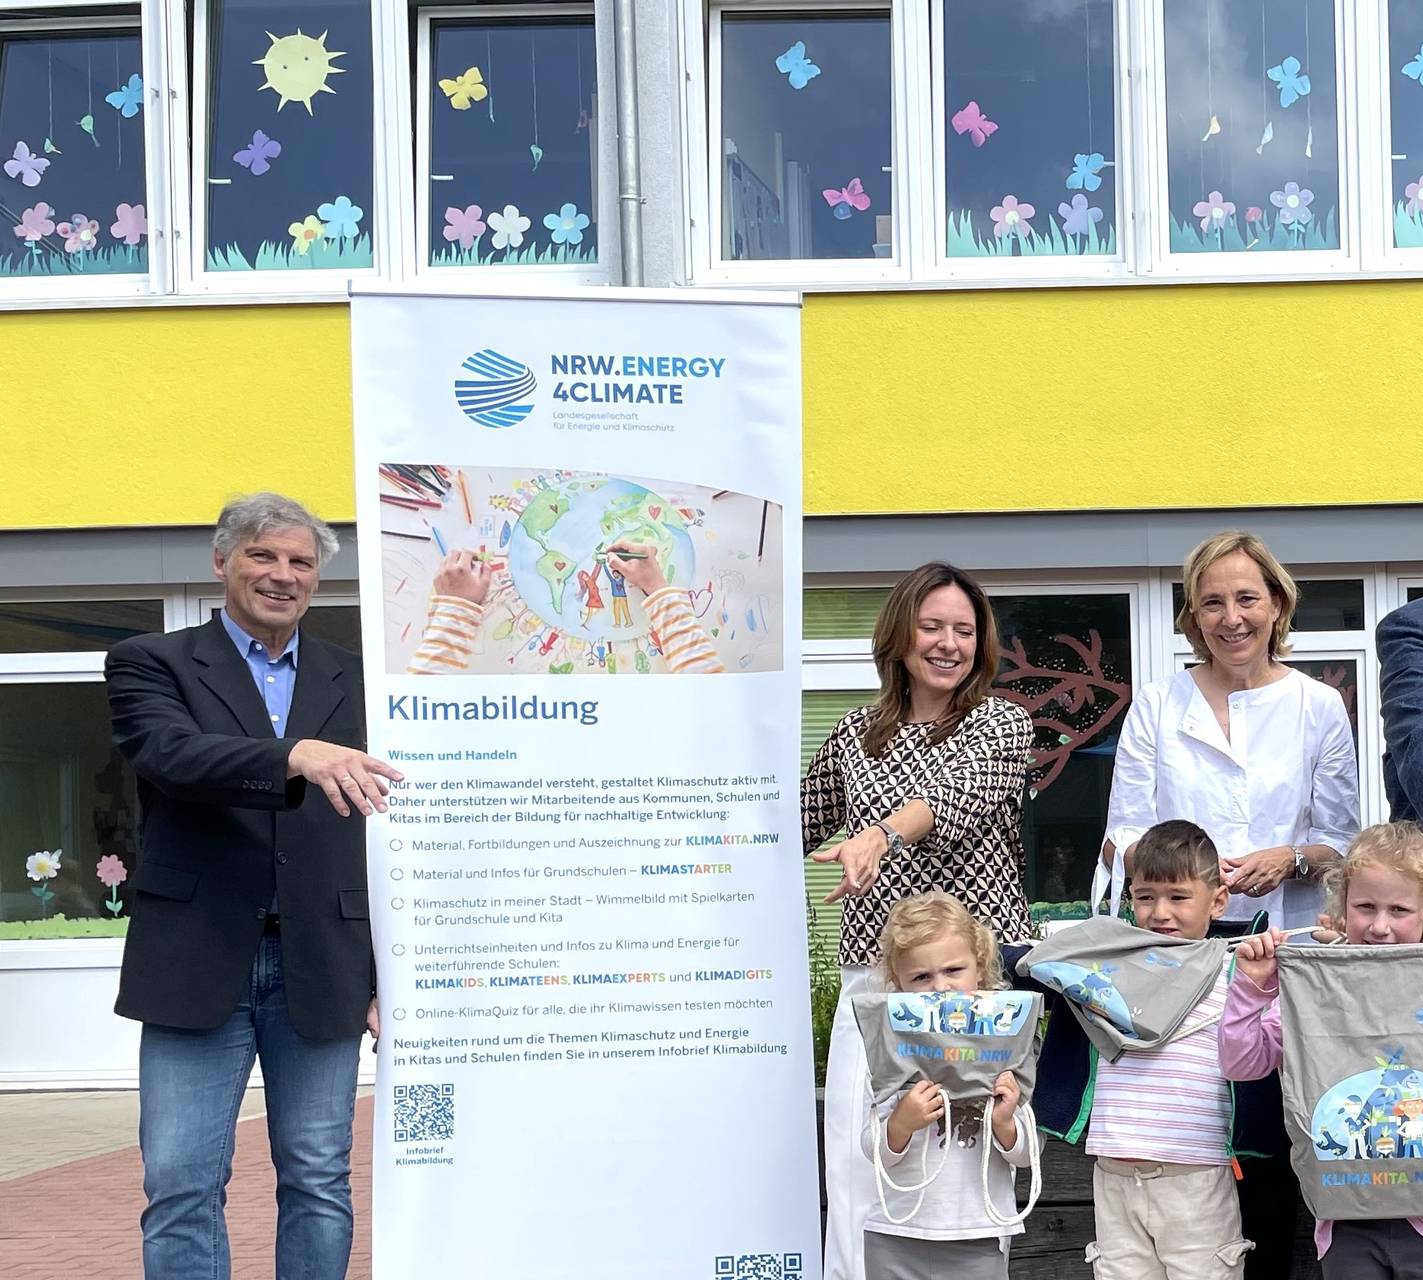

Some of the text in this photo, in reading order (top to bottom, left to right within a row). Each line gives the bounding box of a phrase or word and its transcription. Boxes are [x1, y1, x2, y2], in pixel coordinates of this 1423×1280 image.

[552, 355, 726, 378] NRW.ENERGY
[553, 382, 682, 404] 4CLIMATE
[553, 411, 639, 421] Landesgesellschaft
[553, 422, 566, 430] für
[567, 422, 600, 432] Energie
[623, 423, 674, 432] Klimaschutz
[389, 695, 598, 725] Klimabildung
[388, 750, 517, 760] Wissen und Handeln
[388, 778, 412, 790] Nur
[441, 780, 463, 789] den
[467, 779, 542, 789] Klimawandel
[546, 778, 598, 788] versteht,
[601, 777, 653, 789] gestaltet
[657, 776, 728, 787] Klimaschutz
[732, 776, 758, 785] aktiv
[761, 774, 778, 784] mit.
[389, 796, 426, 807] Daher
[430, 796, 506, 806] unterstützen
[510, 796, 528, 805] wir
[532, 794, 615, 805] Mitarbeitende
[643, 793, 713, 803] Kommunen,
[717, 792, 760, 802] Schulen
[763, 790, 779, 800] und
[390, 809, 729, 824] Kitas im Bereich der Bildung für nachhaltige Entwicklung:
[413, 833, 779, 851] Material, Fortbildungen und Auszeichnung zur KLIMAKITA.NRW
[413, 869, 462, 880] Material
[466, 868, 487, 879] und
[491, 868, 520, 878] Infos
[524, 867, 540, 877] für
[544, 866, 626, 877] Grundschulen
[641, 864, 731, 875] KLIMASTARTER
[414, 898, 487, 908] Klimaschutz
[491, 897, 501, 907] in
[505, 898, 546, 906] meiner
[550, 896, 581, 906] Stadt
[596, 894, 665, 904] Wimmelbild
[669, 894, 688, 903] mit
[692, 892, 754, 904] Spielkarten
[414, 913, 563, 926] für Grundschule und Kita
[415, 937, 739, 955] Unterrichtseinheiten und Infos zu Klima und Energie für
[415, 959, 559, 972] weiterführende Schulen:
[416, 970, 772, 989] KLIMAKIDS, KLIMATEENS, KLIMAEXPERTS und KLIMADIGITS
[416, 999, 773, 1019] Online-KlimaQuiz für alle, die ihr Klimawissen testen möchten
[394, 1028, 749, 1050] Neuigkeiten rund um die Themen Klimaschutz und Energie
[394, 1043, 787, 1066] in Kitas und Schulen finden Sie in unserem Infobrief Klimabildung
[407, 1146, 444, 1155] Infobrief
[396, 1157, 453, 1166] Klimabildung
